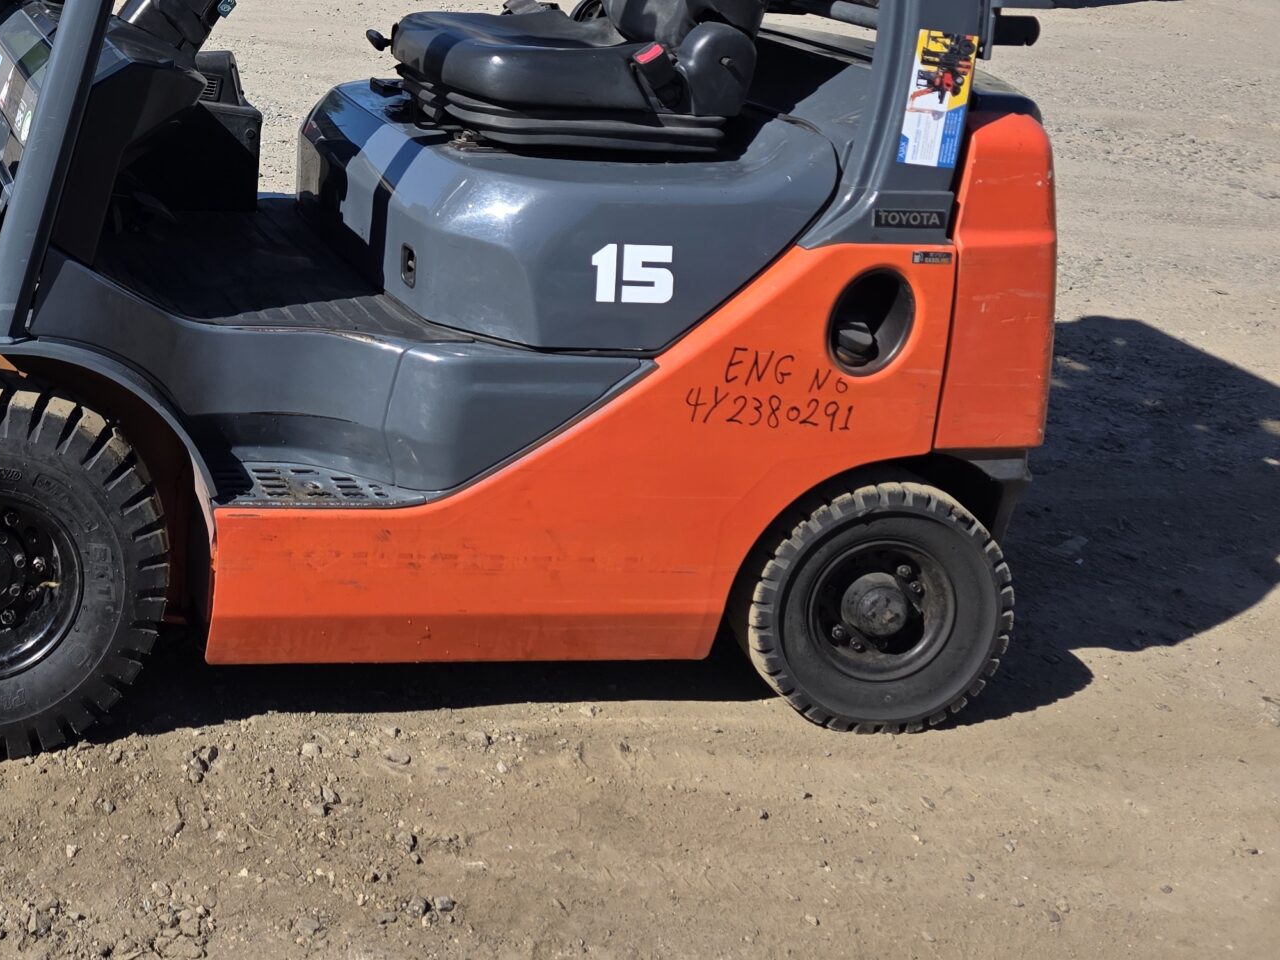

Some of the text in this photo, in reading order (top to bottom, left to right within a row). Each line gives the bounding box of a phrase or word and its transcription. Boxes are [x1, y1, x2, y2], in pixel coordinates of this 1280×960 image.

[879, 212, 940, 225] TOYOTA
[591, 243, 674, 304] 15
[725, 347, 795, 386] ENG
[685, 386, 854, 432] 4Y2380291
